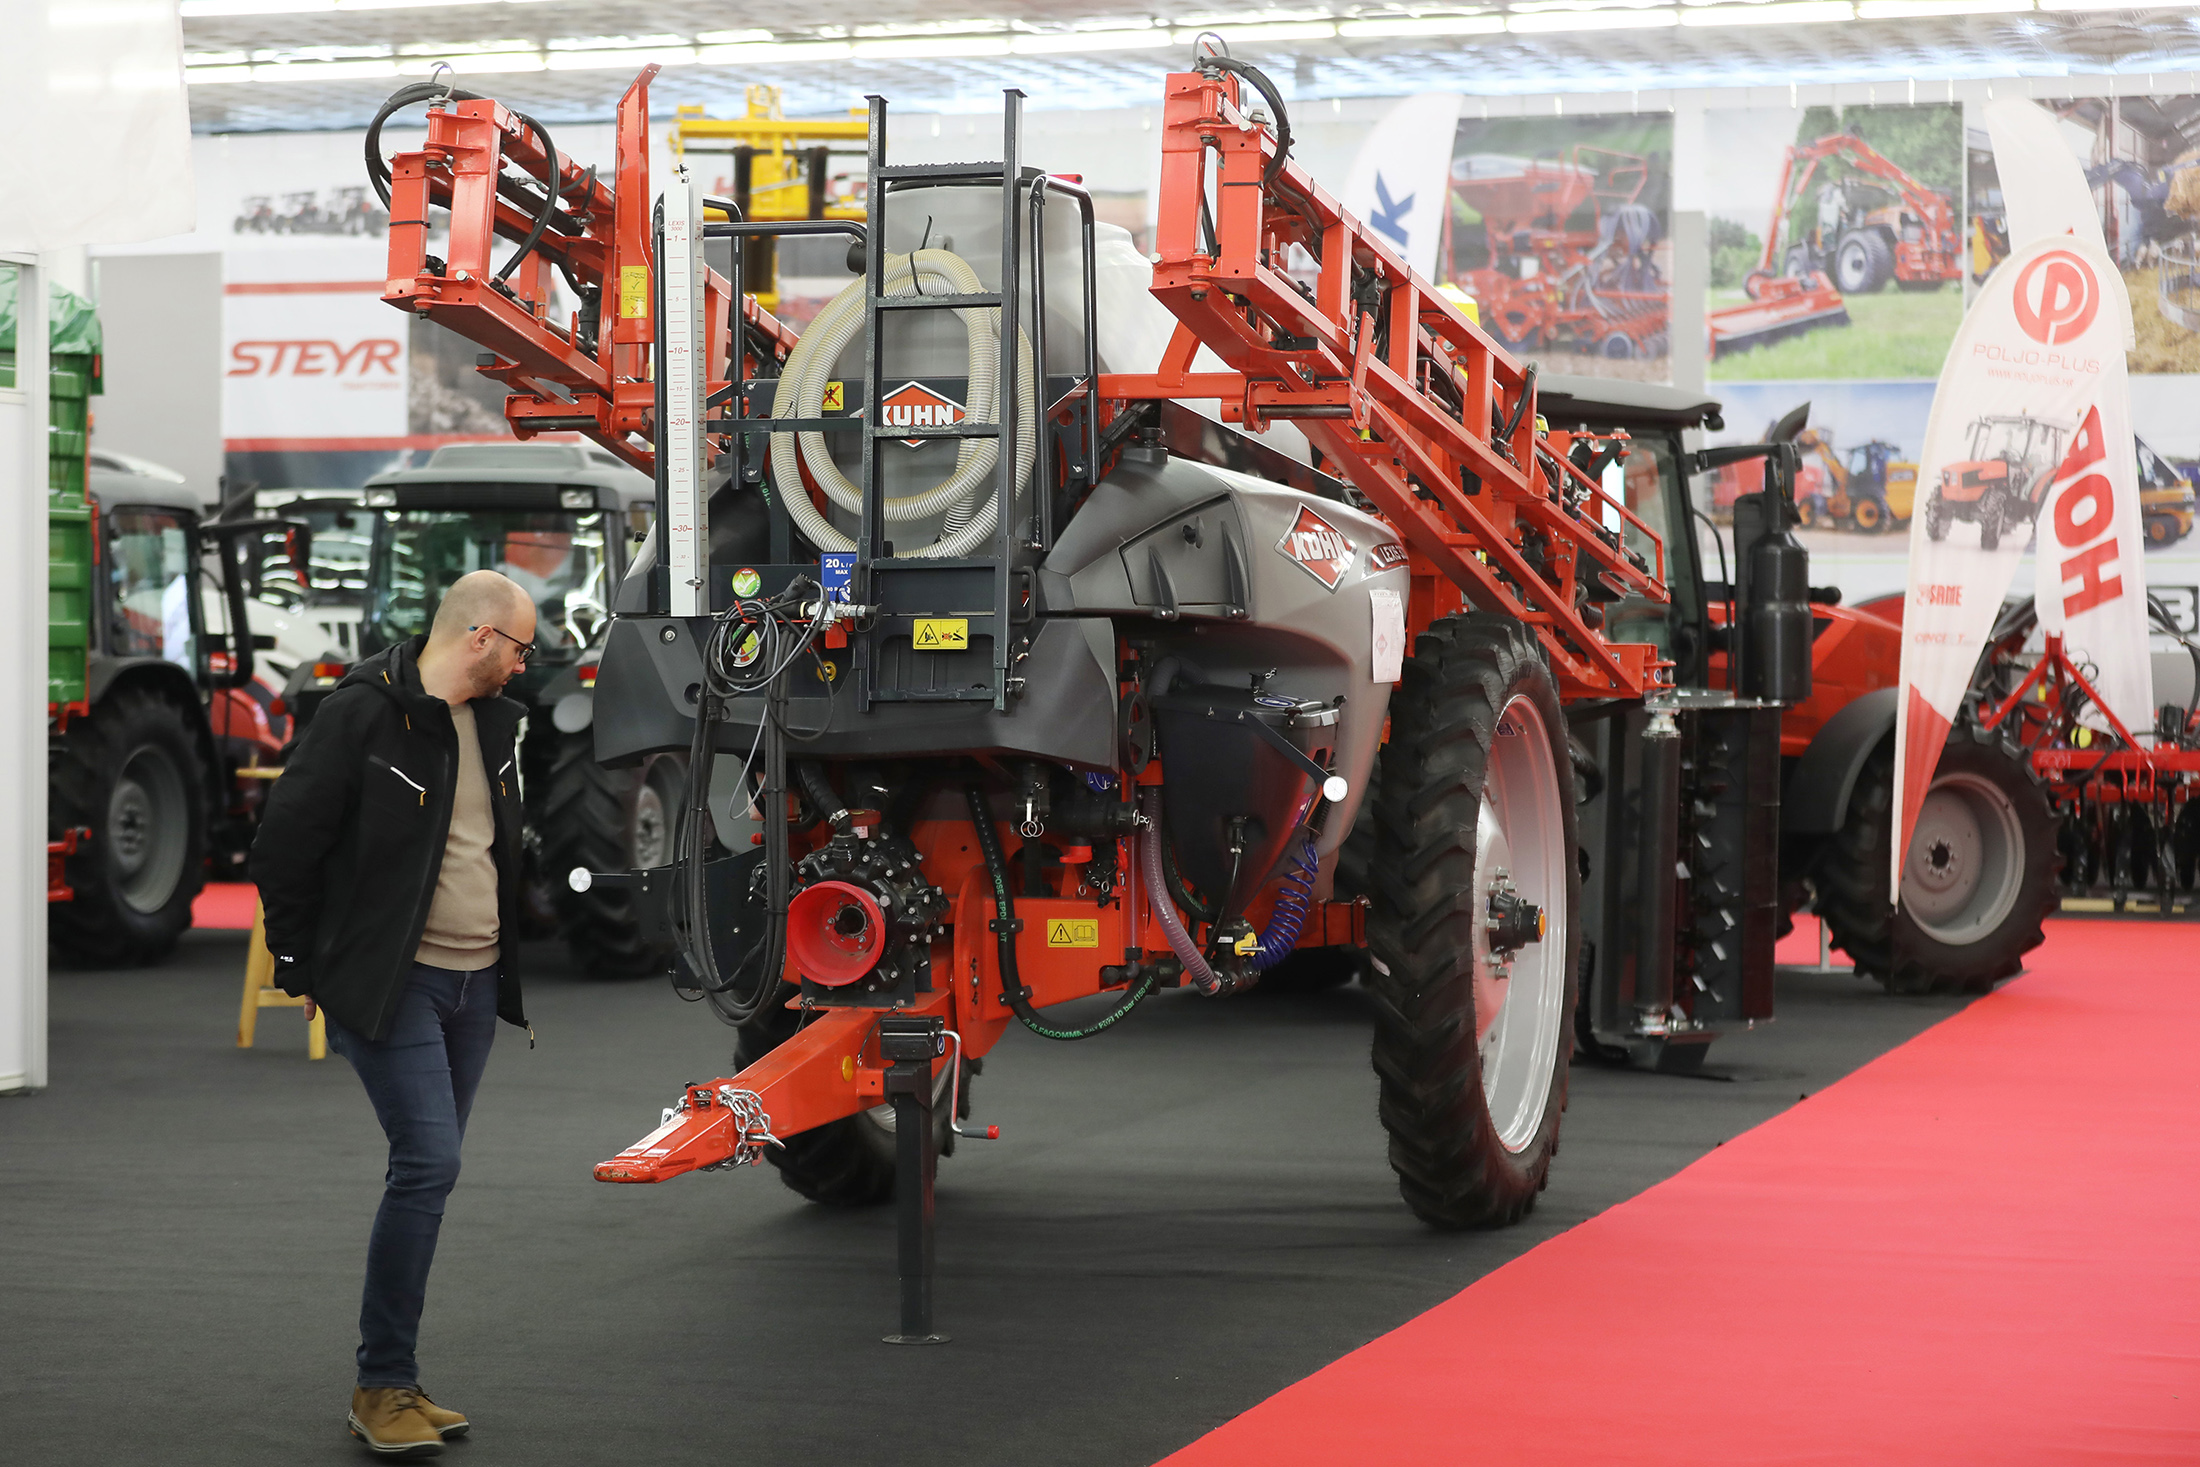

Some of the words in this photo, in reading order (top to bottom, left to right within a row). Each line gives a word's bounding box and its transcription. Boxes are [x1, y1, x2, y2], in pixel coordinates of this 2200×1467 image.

[227, 339, 402, 377] STEYR
[673, 346, 684, 355] 10
[882, 405, 954, 426] KUHN
[677, 525, 689, 533] 30
[825, 558, 840, 568] 20
[1929, 584, 1963, 607] SAME
[1029, 1022, 1084, 1039] ALFAGOMMA
[1114, 1009, 1124, 1019] 10
[1123, 1000, 1135, 1012] bar
